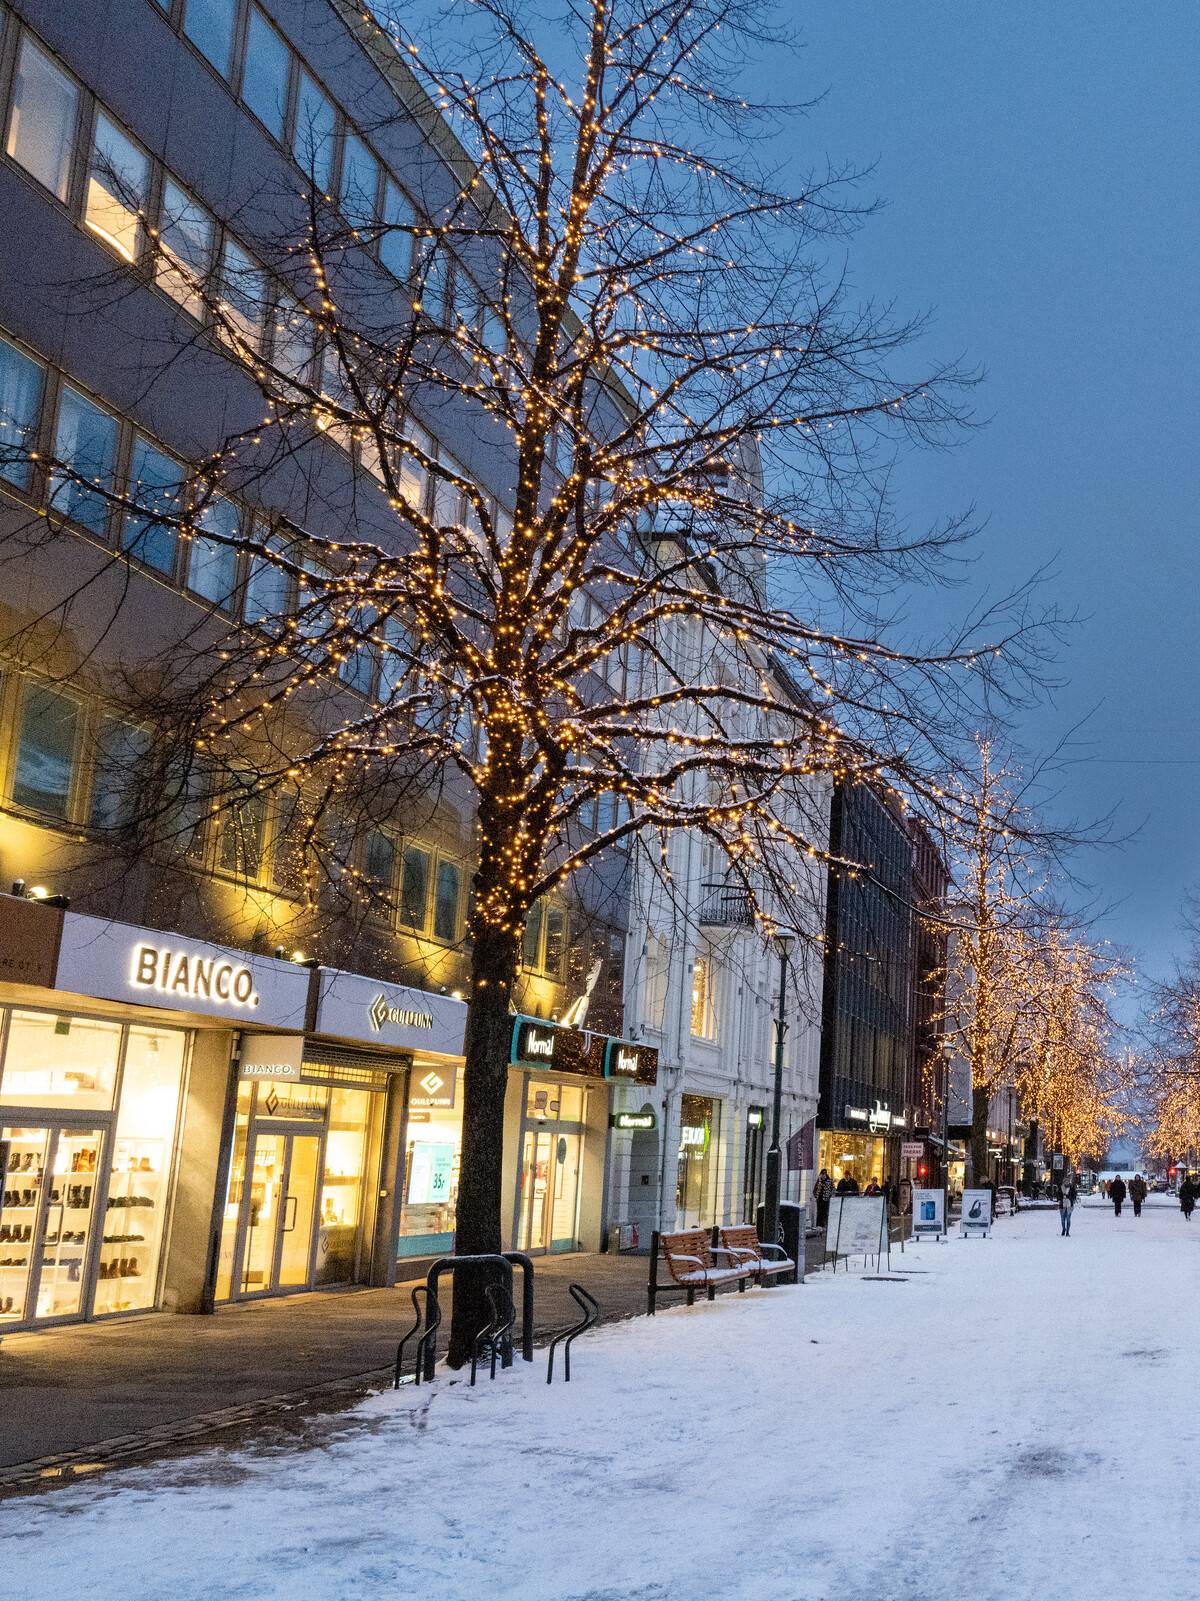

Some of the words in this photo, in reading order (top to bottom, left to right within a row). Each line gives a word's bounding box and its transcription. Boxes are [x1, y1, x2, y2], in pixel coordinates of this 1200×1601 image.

[135, 947, 260, 1006] BIANCO.
[528, 1030, 554, 1055] Normal
[243, 1065, 295, 1074] BIANCO.
[617, 1049, 639, 1071] Normal
[620, 1115, 652, 1128] Normal
